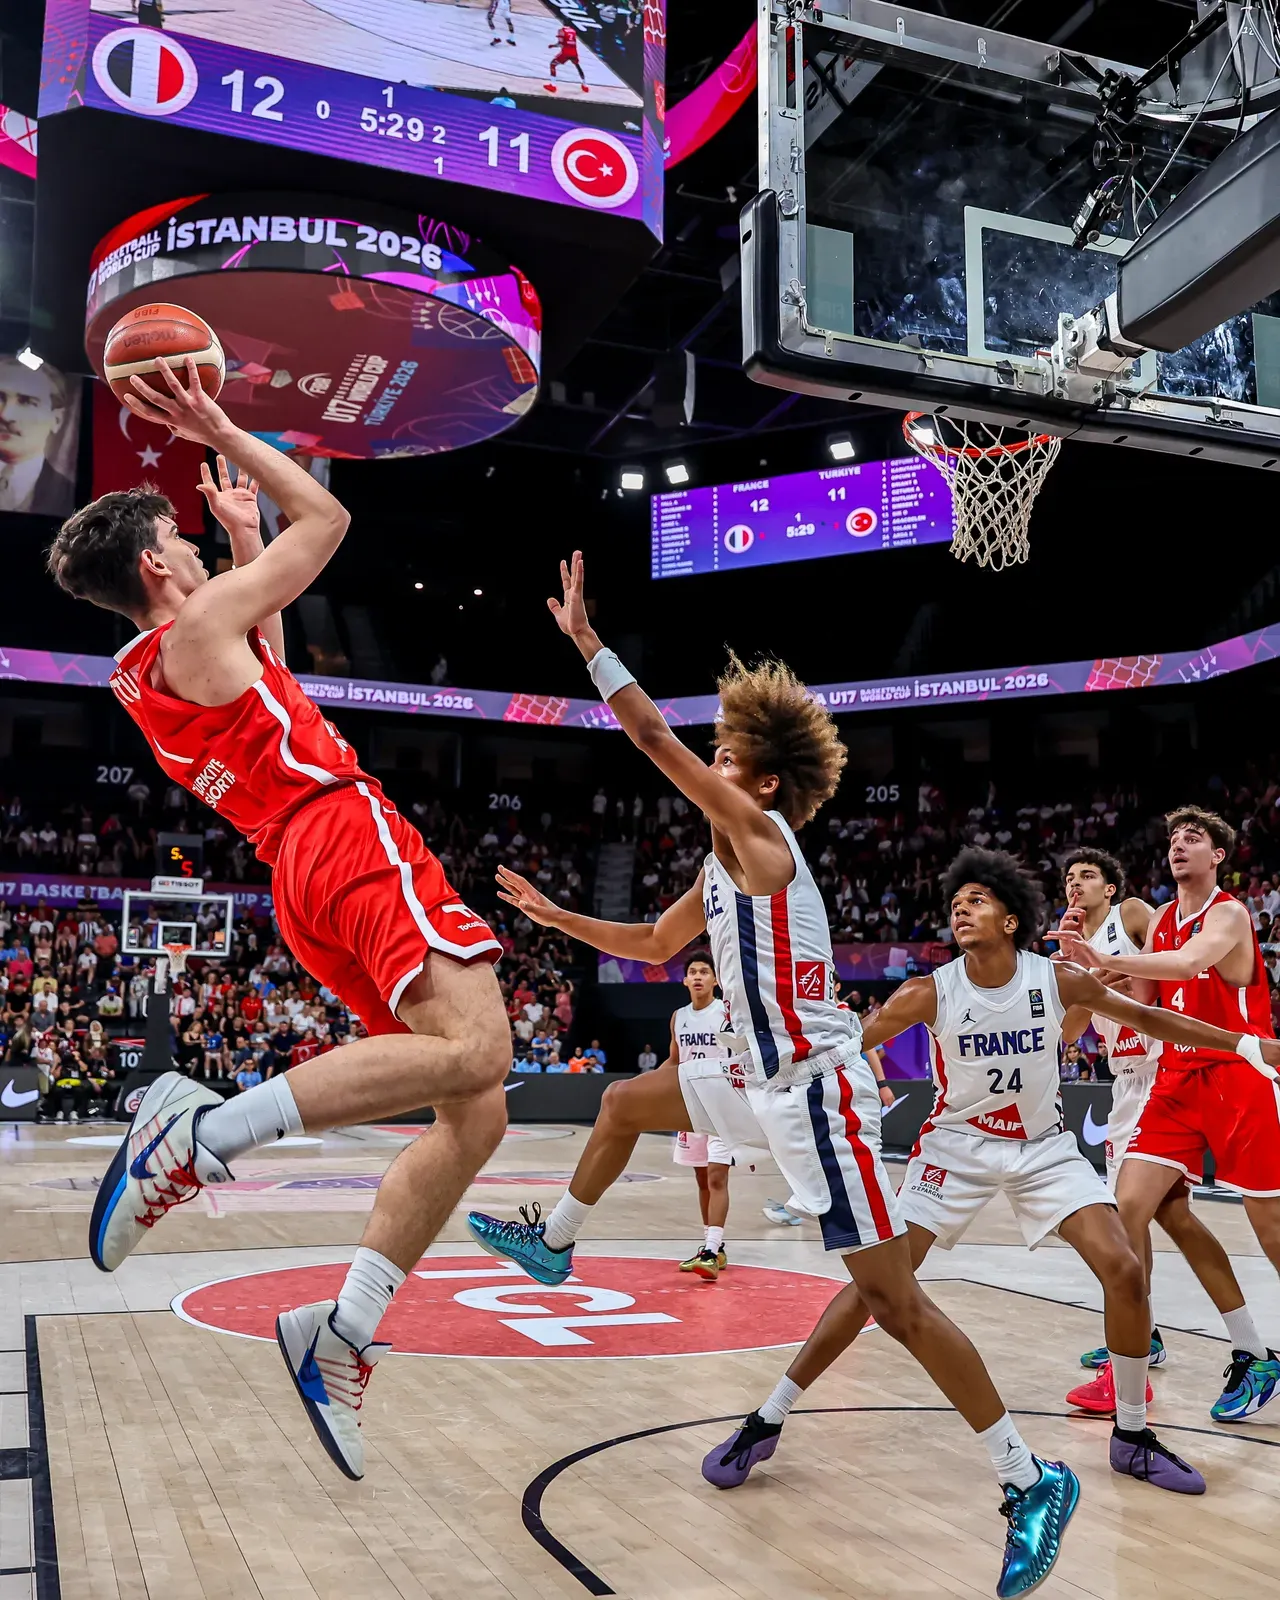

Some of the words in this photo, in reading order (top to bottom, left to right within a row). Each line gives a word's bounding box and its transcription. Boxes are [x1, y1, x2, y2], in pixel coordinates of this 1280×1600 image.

[221, 69, 285, 121] 12
[382, 86, 394, 108] 1
[316, 100, 331, 119] 0
[359, 107, 425, 142] 5:29
[432, 125, 446, 145] 2
[478, 125, 530, 174] 11
[433, 156, 443, 175] 1
[98, 230, 161, 275] BASKETBALL
[355, 225, 443, 271] 2026
[98, 253, 132, 286] WORLD
[133, 243, 160, 262] CUP
[134, 308, 160, 319] FIBA
[321, 398, 363, 423] U17
[733, 480, 769, 493] FRANCE
[827, 487, 846, 502] 11
[750, 498, 769, 513] 12
[794, 512, 802, 522] 1
[786, 523, 815, 538] 5:29
[829, 689, 857, 705] U17
[1004, 672, 1049, 690] 2026
[860, 684, 911, 696] BASKETBALL
[860, 692, 892, 703] WORLD
[893, 690, 911, 700] CUP
[433, 693, 474, 710] 2026
[96, 765, 134, 784] 207
[488, 793, 522, 811] 206
[865, 784, 900, 803] 205
[21, 882, 142, 900] BASKETBA
[225, 892, 258, 906] UP
[1171, 987, 1185, 1012] 4
[679, 1032, 718, 1047] FRANCE
[957, 1026, 1046, 1057] FRANCE
[1116, 1036, 1141, 1053] MAIF
[119, 1051, 143, 1068] 10
[986, 1067, 1023, 1095] 24
[1122, 1068, 1135, 1076] FRA
[977, 1113, 1023, 1132] MAIF
[919, 1181, 941, 1192] CAISSE
[411, 1261, 684, 1347] TCL
